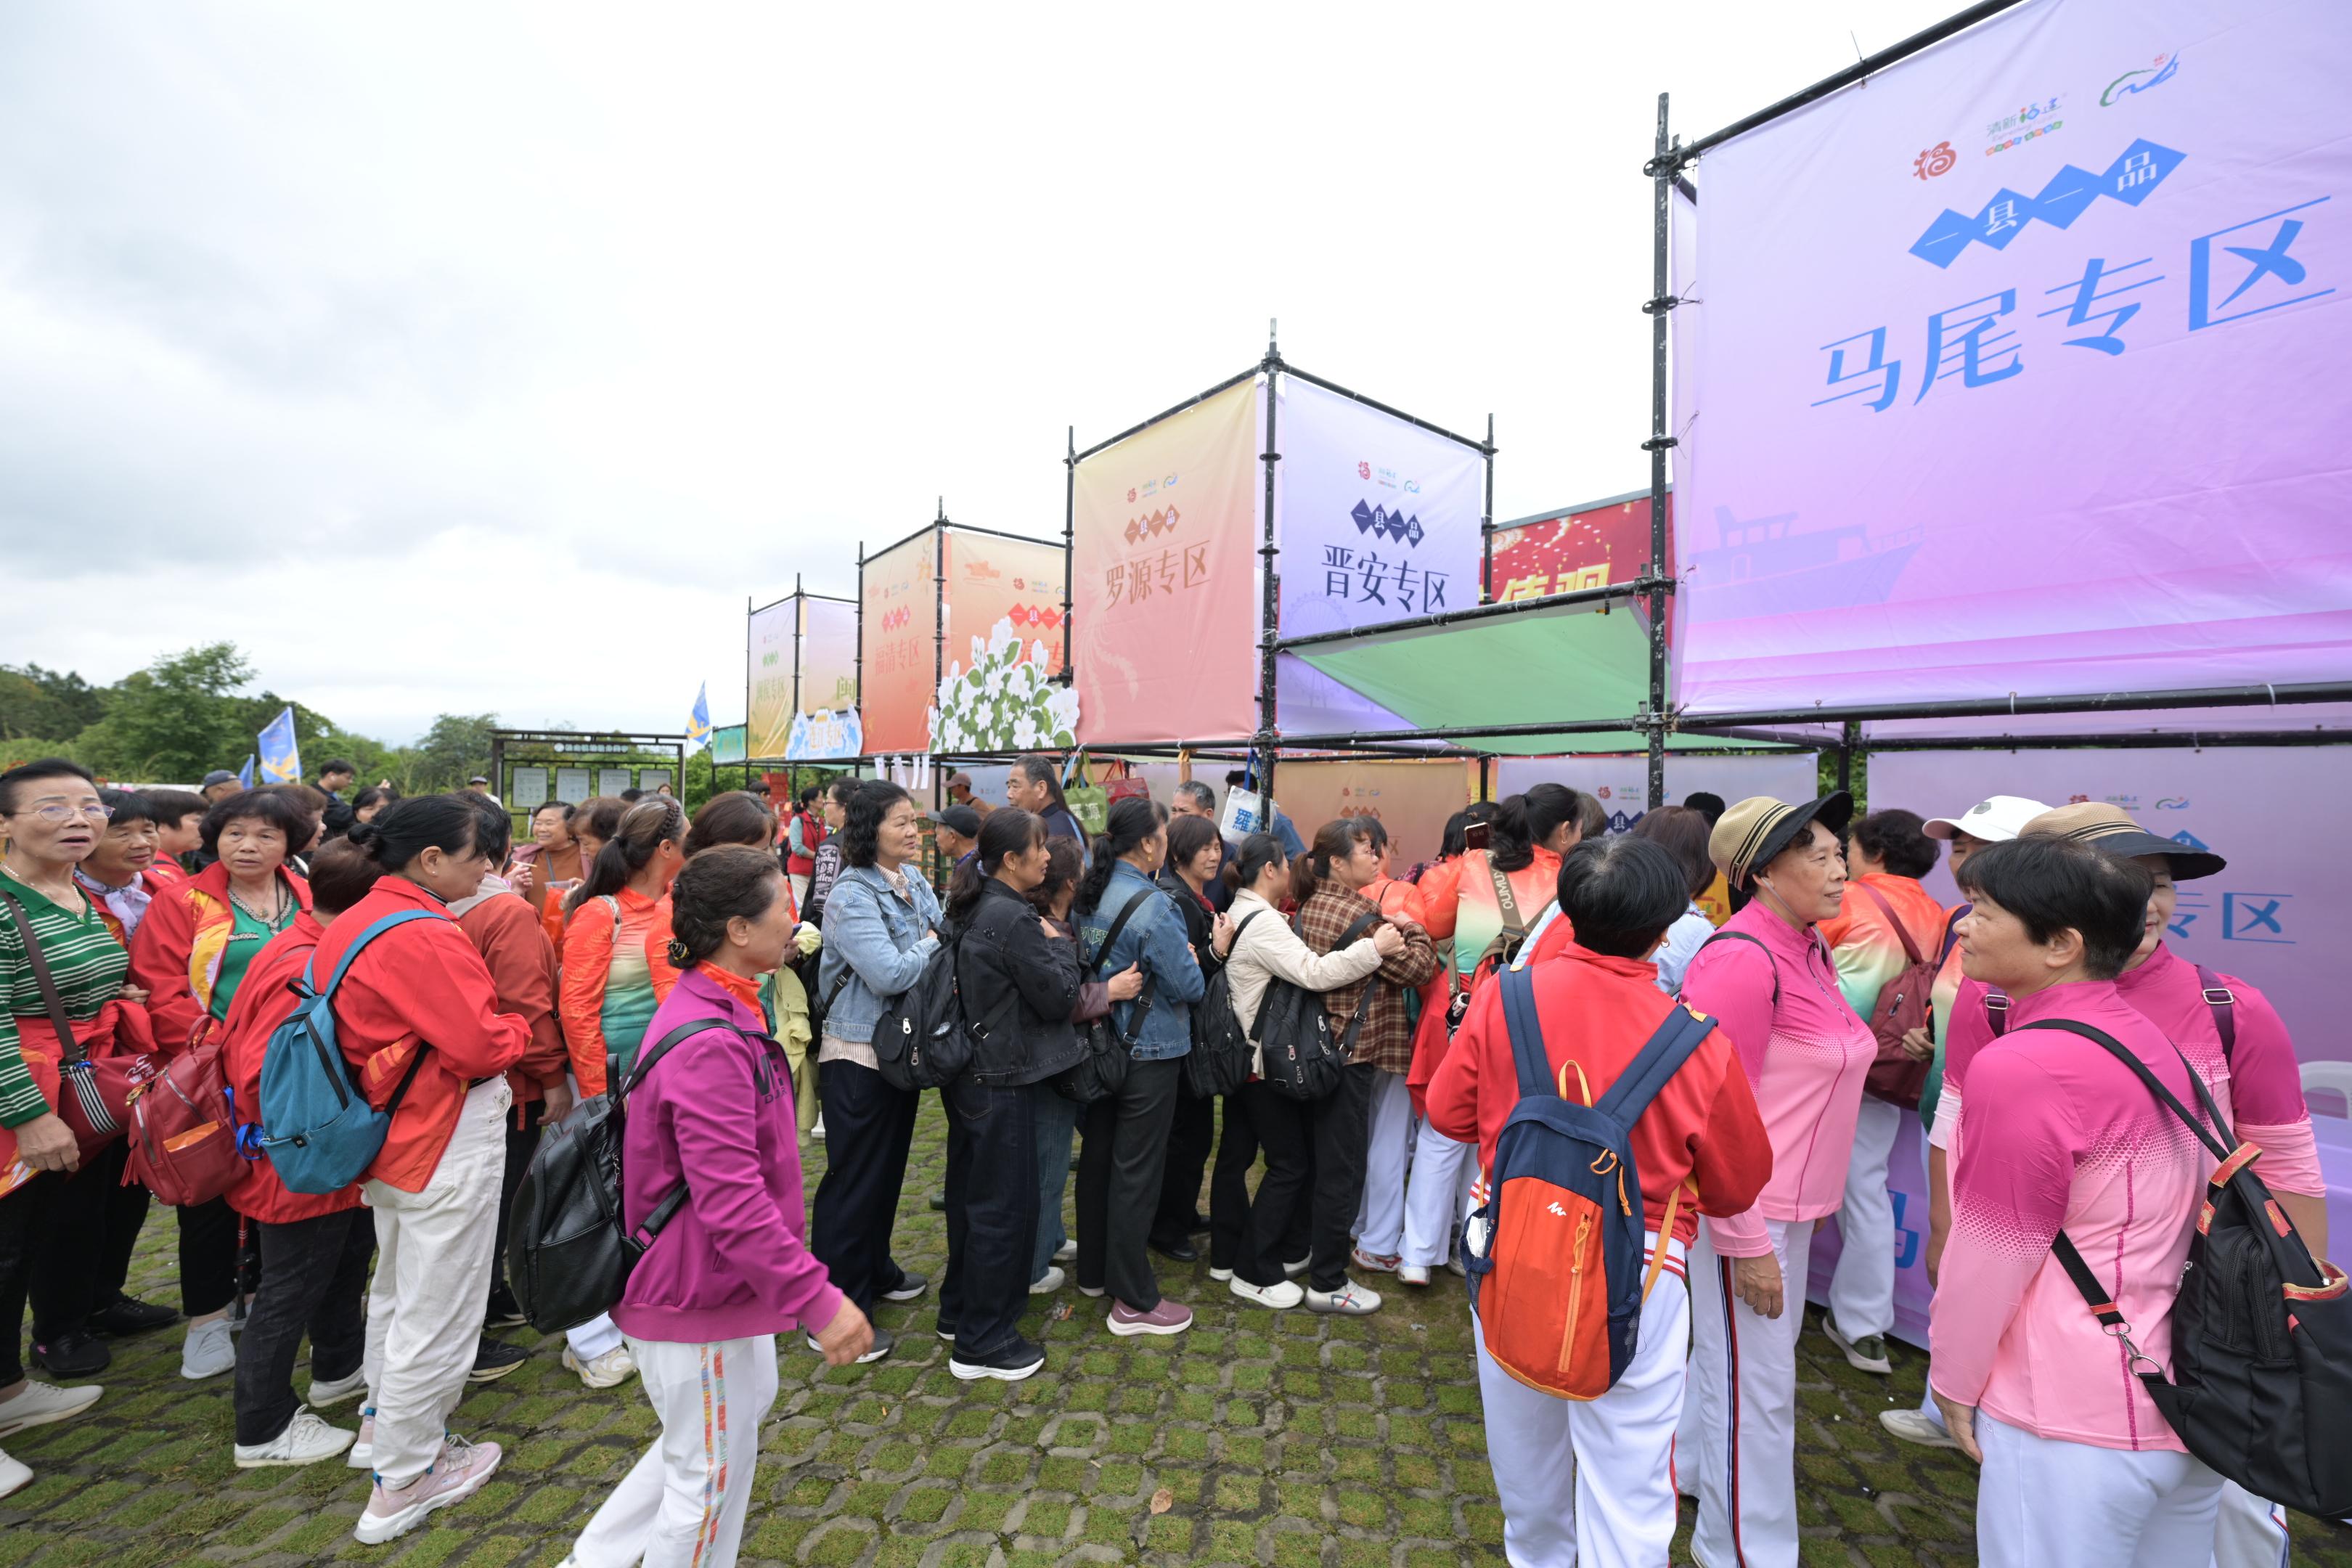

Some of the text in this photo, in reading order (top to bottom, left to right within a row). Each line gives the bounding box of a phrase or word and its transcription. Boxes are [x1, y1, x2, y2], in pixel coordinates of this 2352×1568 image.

[1924, 150, 2158, 248] 一县一品
[1810, 195, 2337, 414] 马尾专区
[1126, 509, 1176, 536] 一县一品
[1355, 510, 1420, 539] 一县一品
[1105, 539, 1211, 611] 罗源专区
[1321, 544, 1450, 614] 晋安专区
